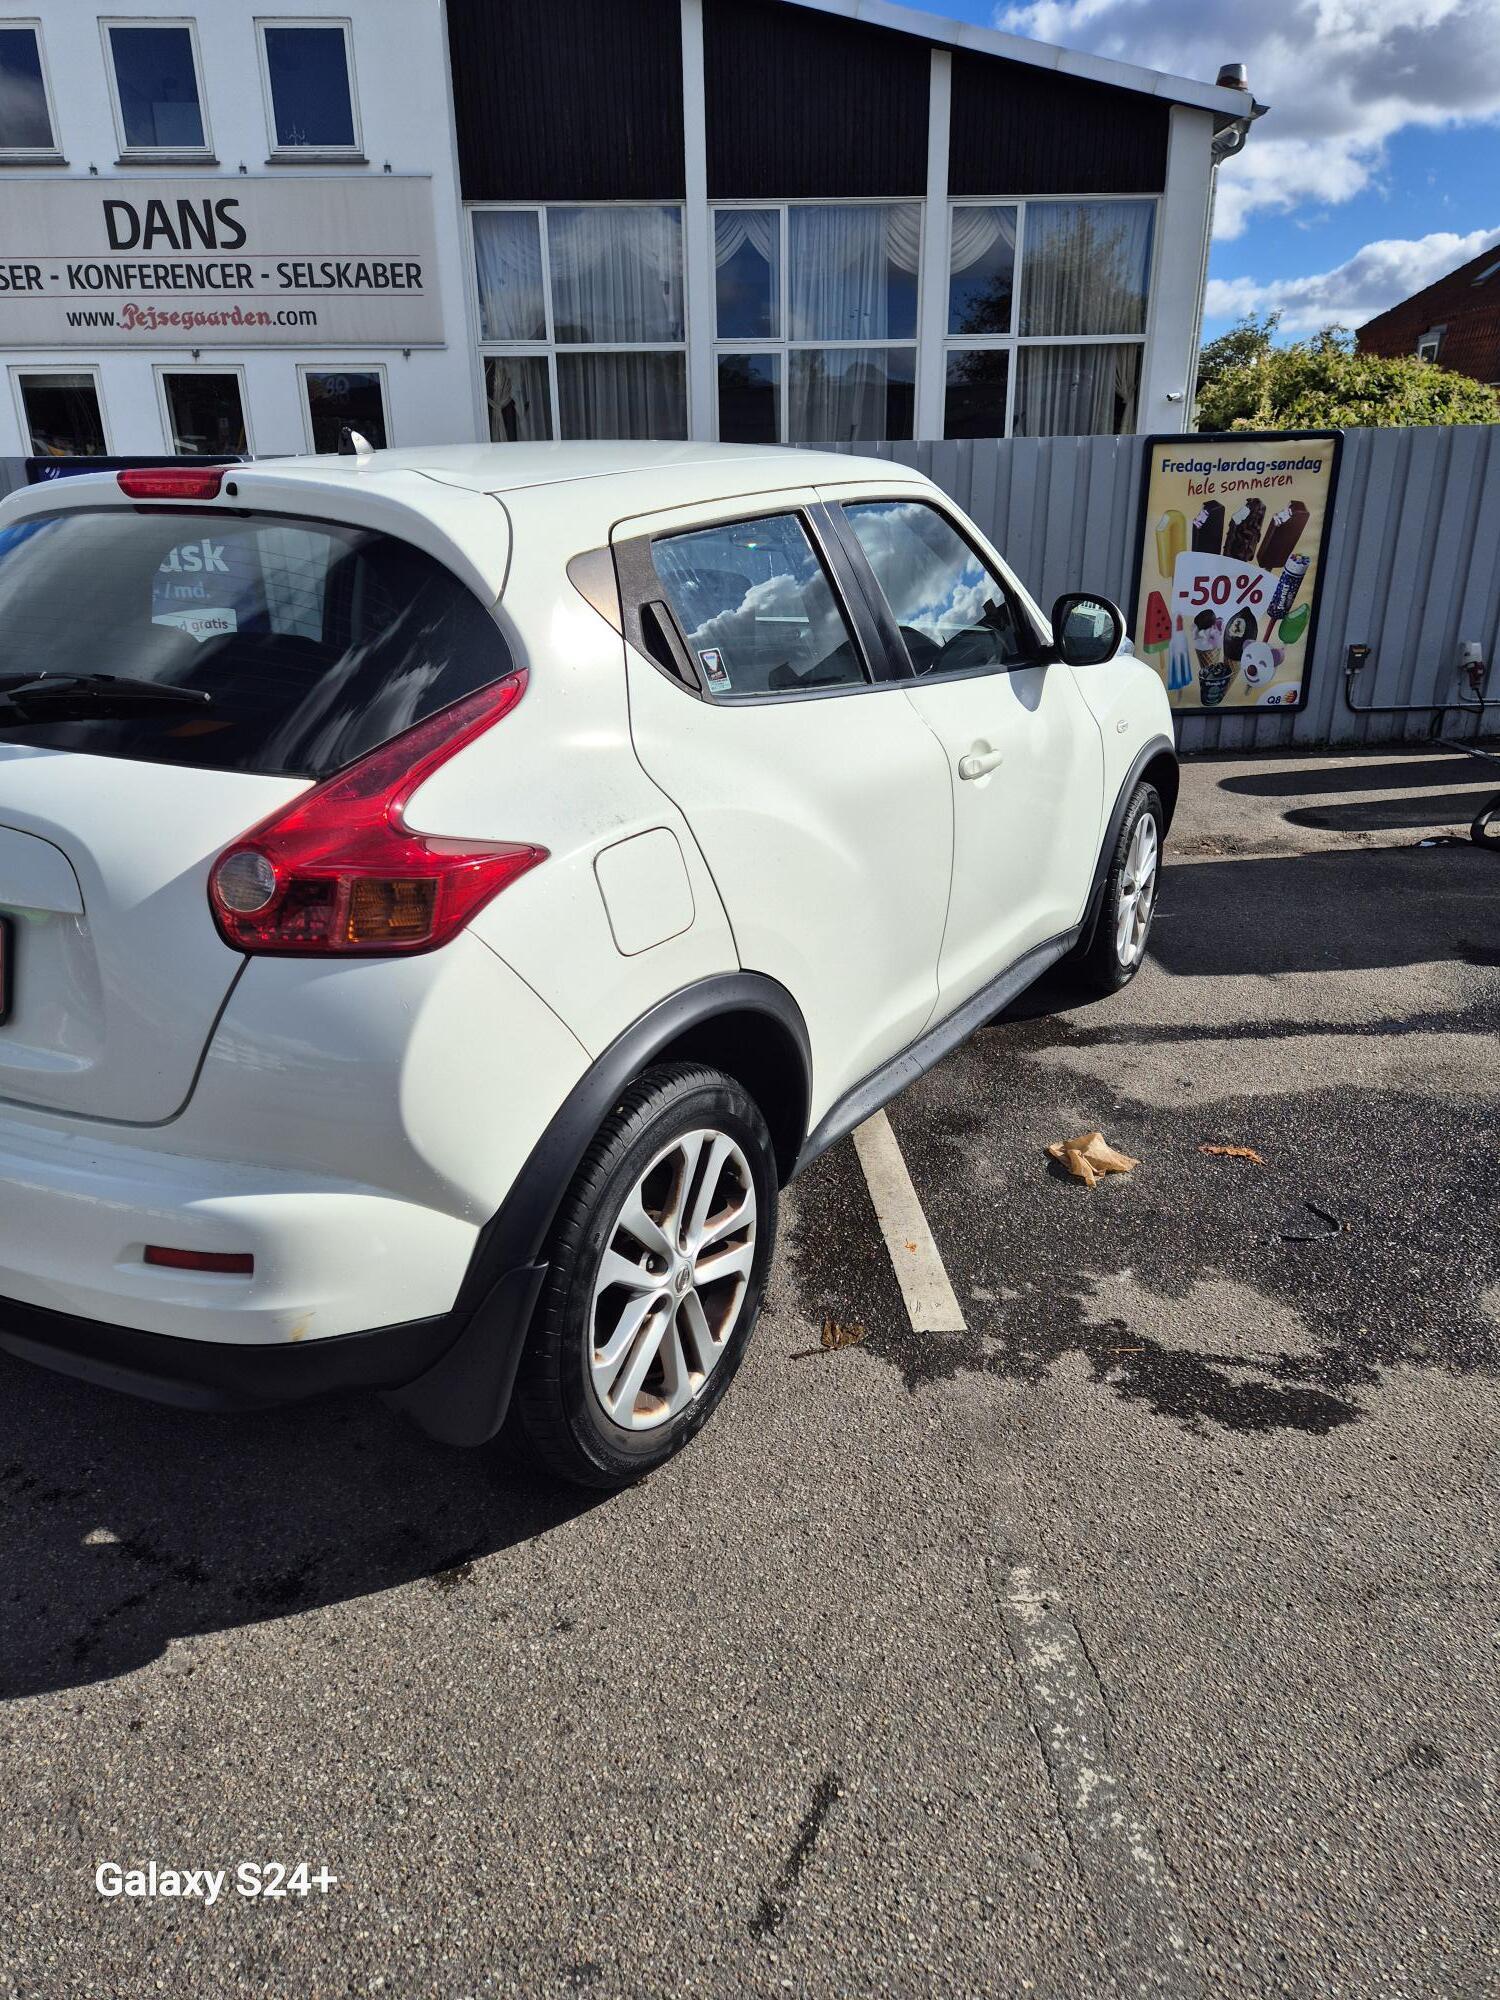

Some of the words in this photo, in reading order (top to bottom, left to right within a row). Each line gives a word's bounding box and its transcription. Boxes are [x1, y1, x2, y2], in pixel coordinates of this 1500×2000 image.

[102, 198, 247, 251] DANS
[67, 264, 254, 290] KONFERENCER
[278, 262, 423, 289] SELSKABER
[66, 303, 318, 331] www.Pejsegaarden.com
[1161, 456, 1323, 476] Fredag-lørdag-søndag
[1187, 477, 1216, 496] hele
[1220, 474, 1293, 493] sommeren
[1179, 574, 1264, 606] -50%
[191, 618, 229, 633] gratis
[1267, 695, 1282, 705] Q8
